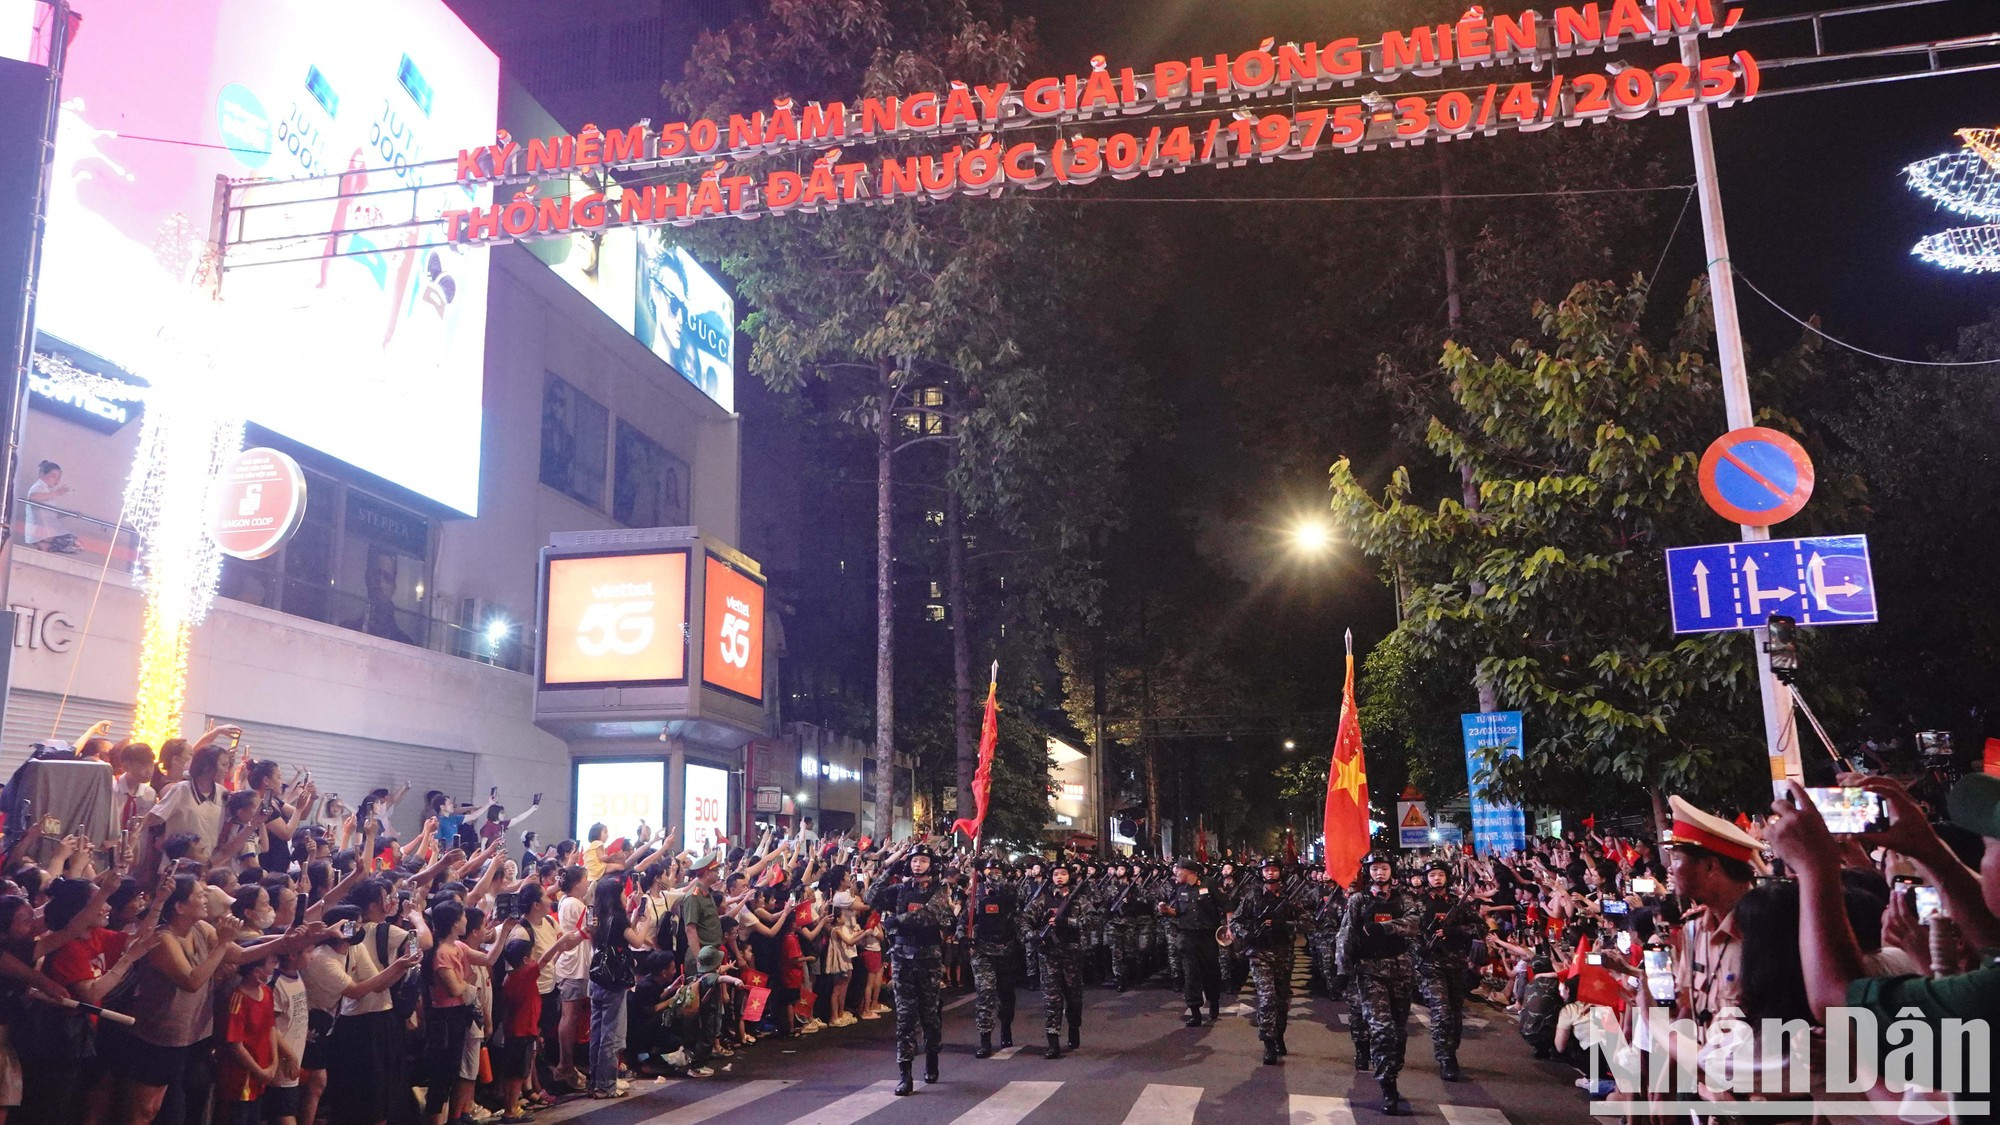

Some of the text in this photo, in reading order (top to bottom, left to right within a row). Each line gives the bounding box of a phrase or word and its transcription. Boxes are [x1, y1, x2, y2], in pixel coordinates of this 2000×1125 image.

[456, 129, 517, 181] KỶ
[526, 122, 646, 176] NIỆM
[659, 118, 719, 156] 50
[728, 98, 846, 148] NĂM
[862, 80, 1010, 133] NGÀY
[1023, 54, 1135, 113] GIẢI
[1154, 36, 1363, 98] PHÓNG
[1382, 5, 1537, 68] MIỀN
[442, 184, 606, 242] THỐNG
[620, 160, 751, 222] NHẤT
[764, 148, 867, 208] ĐẤT
[881, 133, 1037, 195] NƯỚC
[221, 518, 250, 528] SAIGON
[591, 581, 655, 598] viettel
[726, 595, 750, 618] viettel
[576, 600, 654, 657] 5G
[719, 612, 750, 668] 5G
[590, 793, 650, 817] 300
[695, 797, 719, 822] 300
